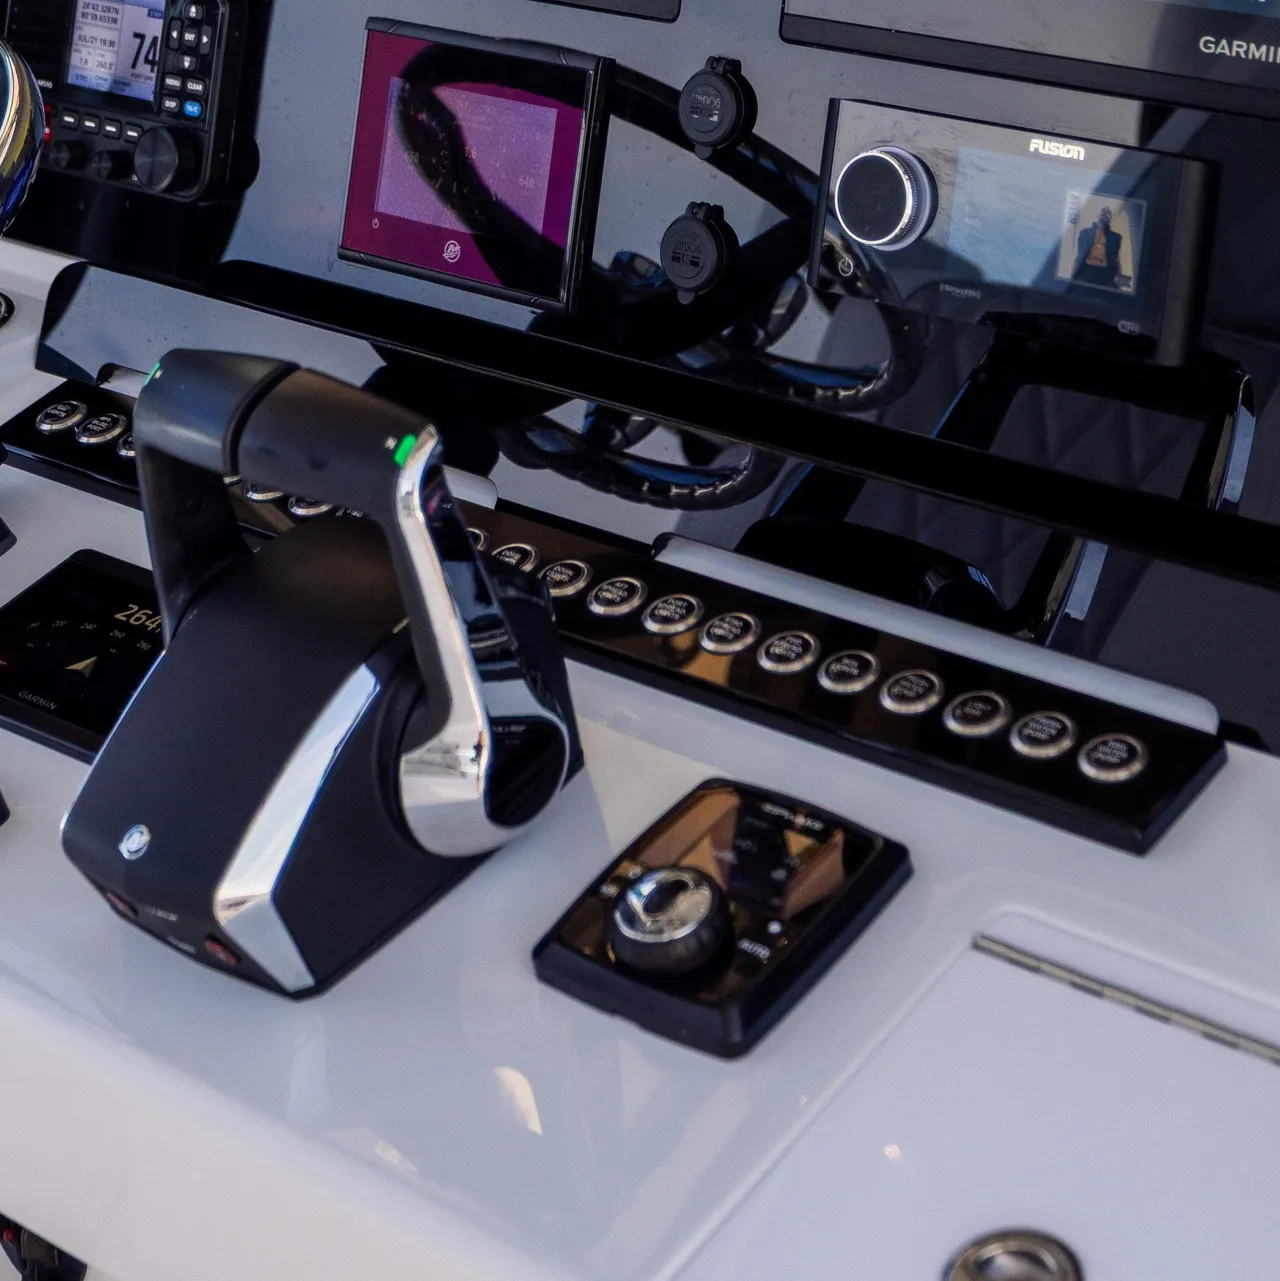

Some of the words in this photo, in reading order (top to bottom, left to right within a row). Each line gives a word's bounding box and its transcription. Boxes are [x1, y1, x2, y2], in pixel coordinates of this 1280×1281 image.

[131, 31, 159, 74] 74
[187, 82, 203, 91] CLEAR
[1029, 138, 1085, 161] FUSION
[18, 689, 58, 711] GARMIN
[739, 937, 771, 960] AUTO
